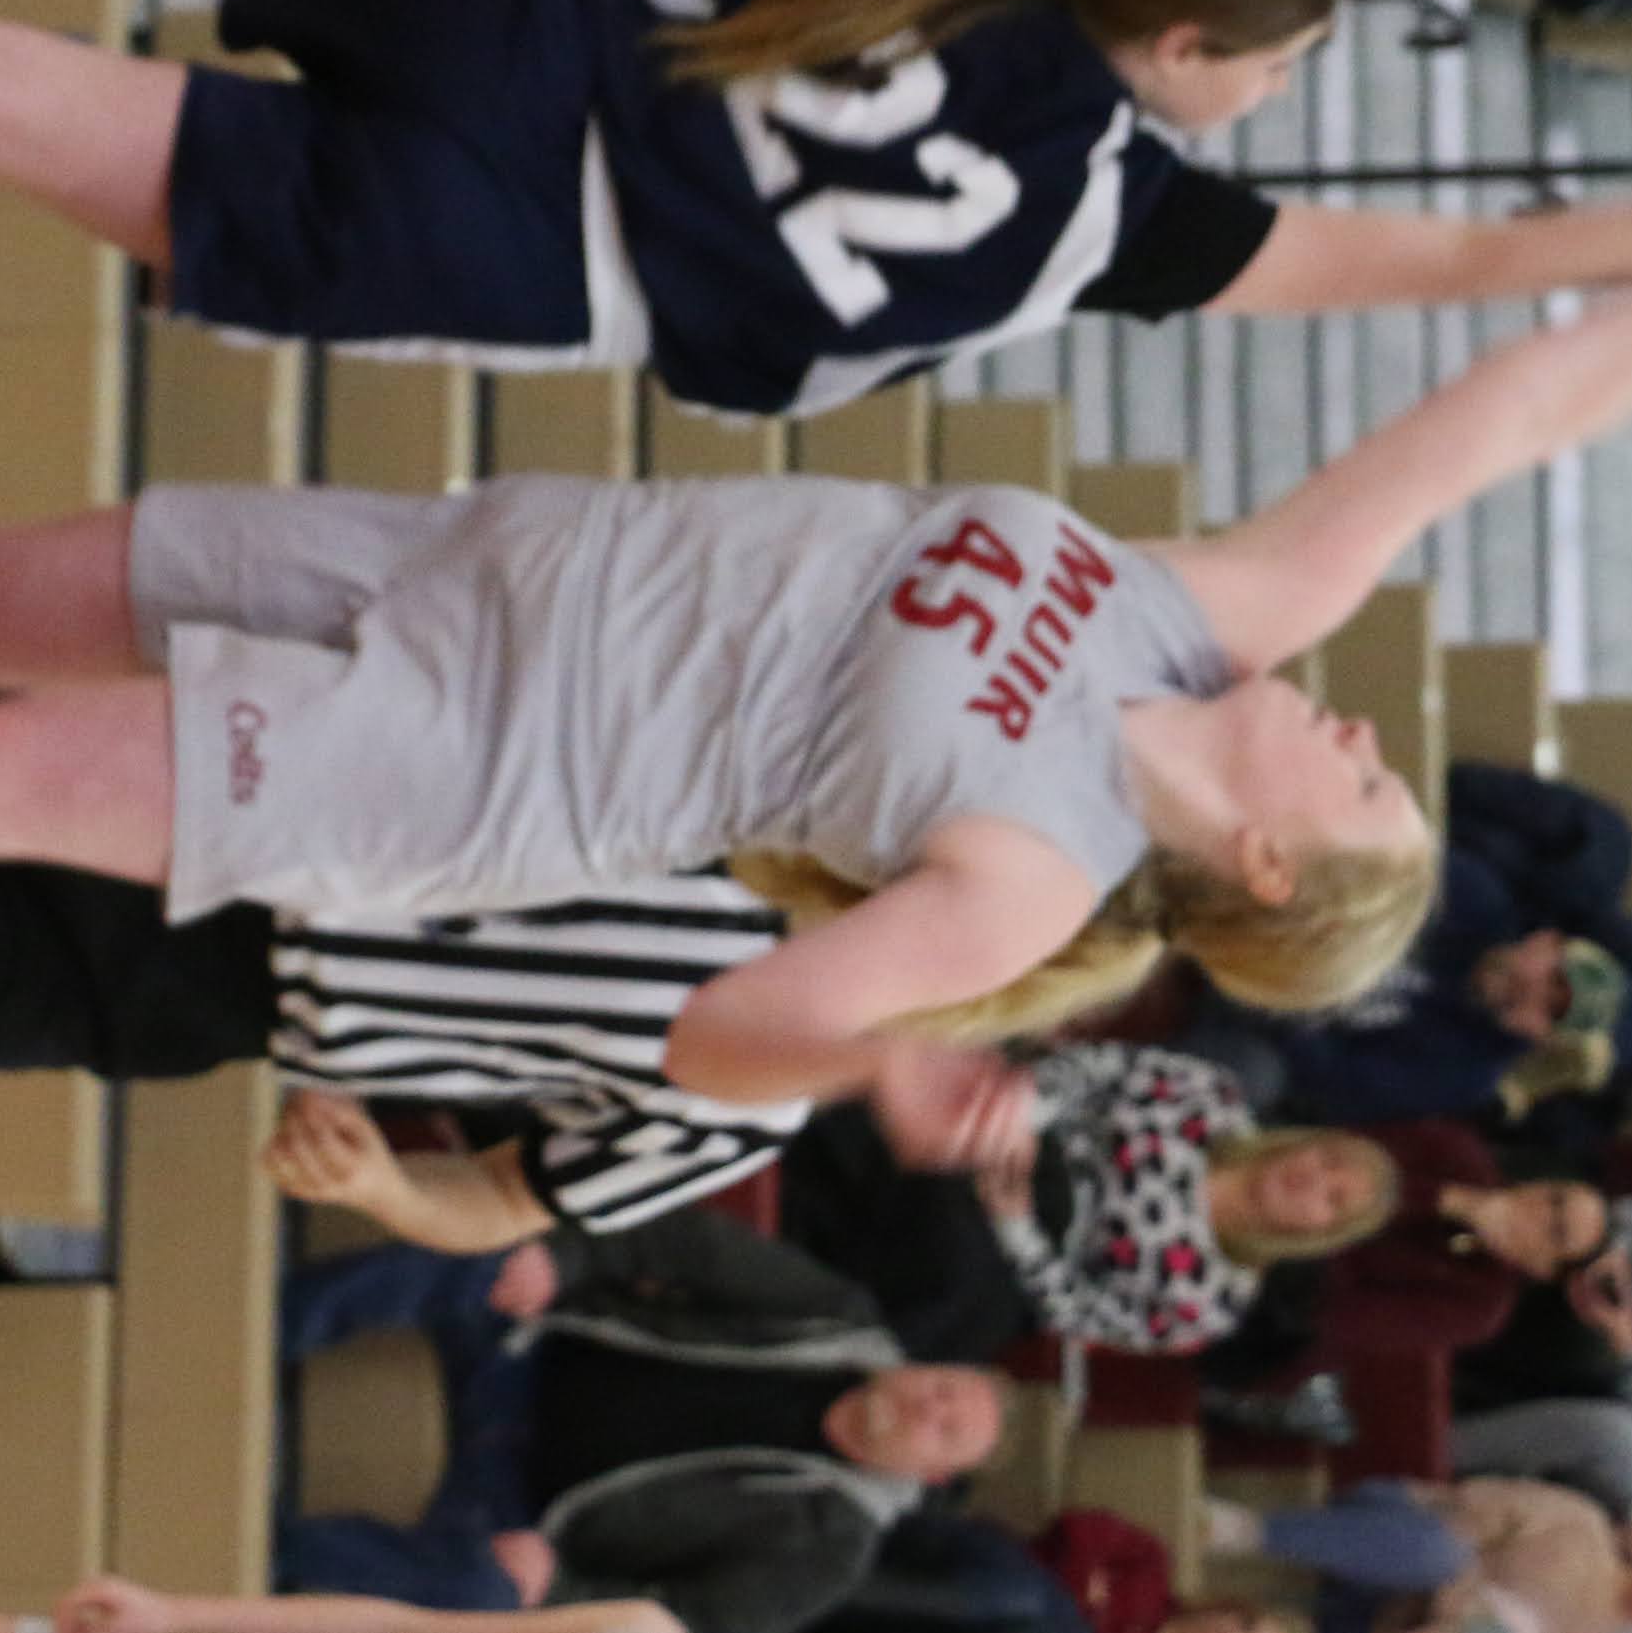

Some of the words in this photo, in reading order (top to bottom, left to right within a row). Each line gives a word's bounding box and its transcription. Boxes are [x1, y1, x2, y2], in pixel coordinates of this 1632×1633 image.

[724, 28, 1020, 328] 22
[889, 520, 1024, 657] 45
[965, 522, 1115, 743] MUIR
